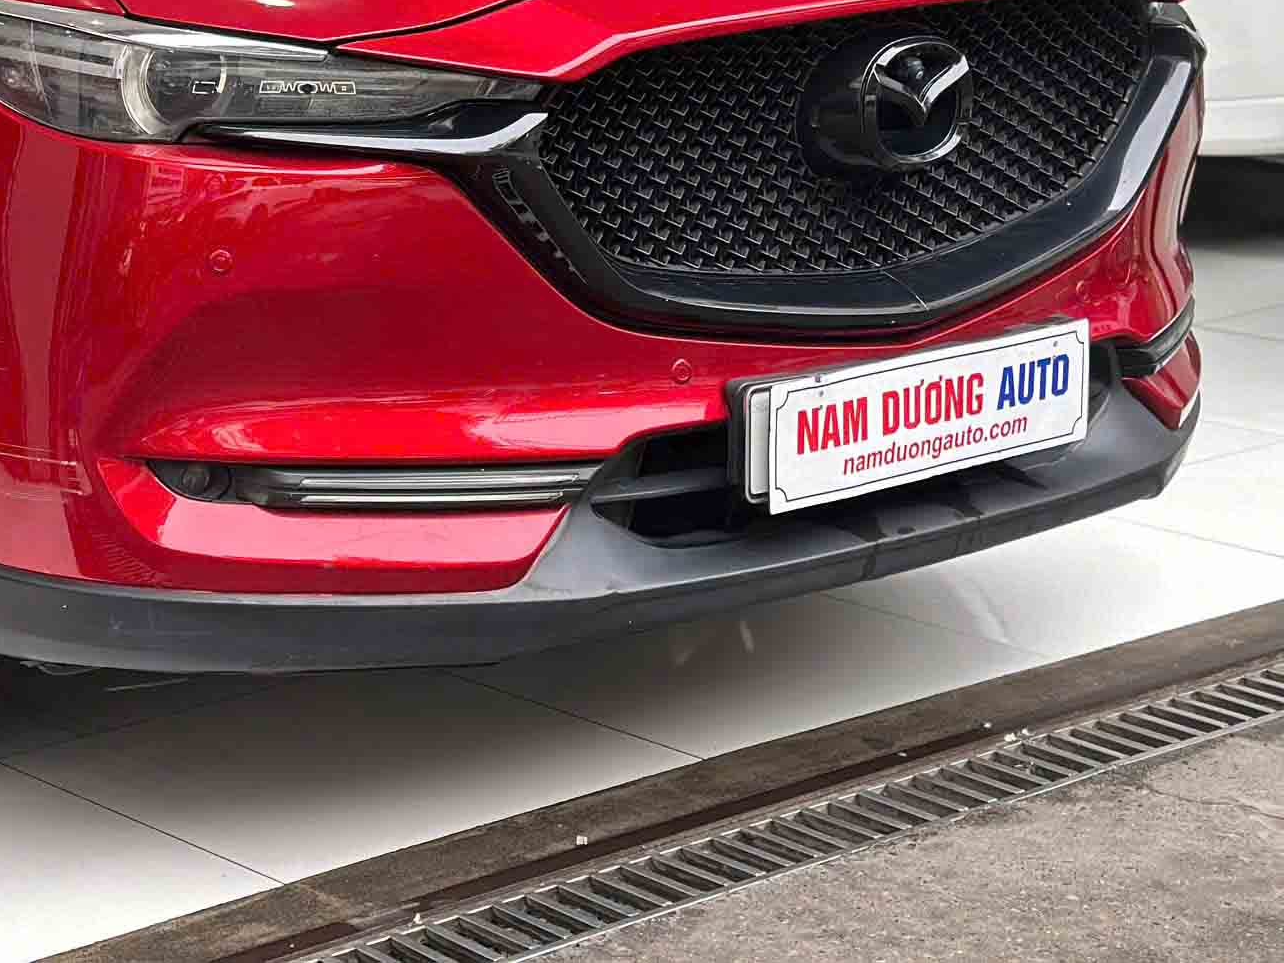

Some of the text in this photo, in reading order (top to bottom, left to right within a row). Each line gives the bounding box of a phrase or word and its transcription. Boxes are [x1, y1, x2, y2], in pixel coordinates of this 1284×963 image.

[797, 353, 1069, 455] NAM DƯƠNG AUTO
[843, 416, 1027, 476] namduongauto.com
